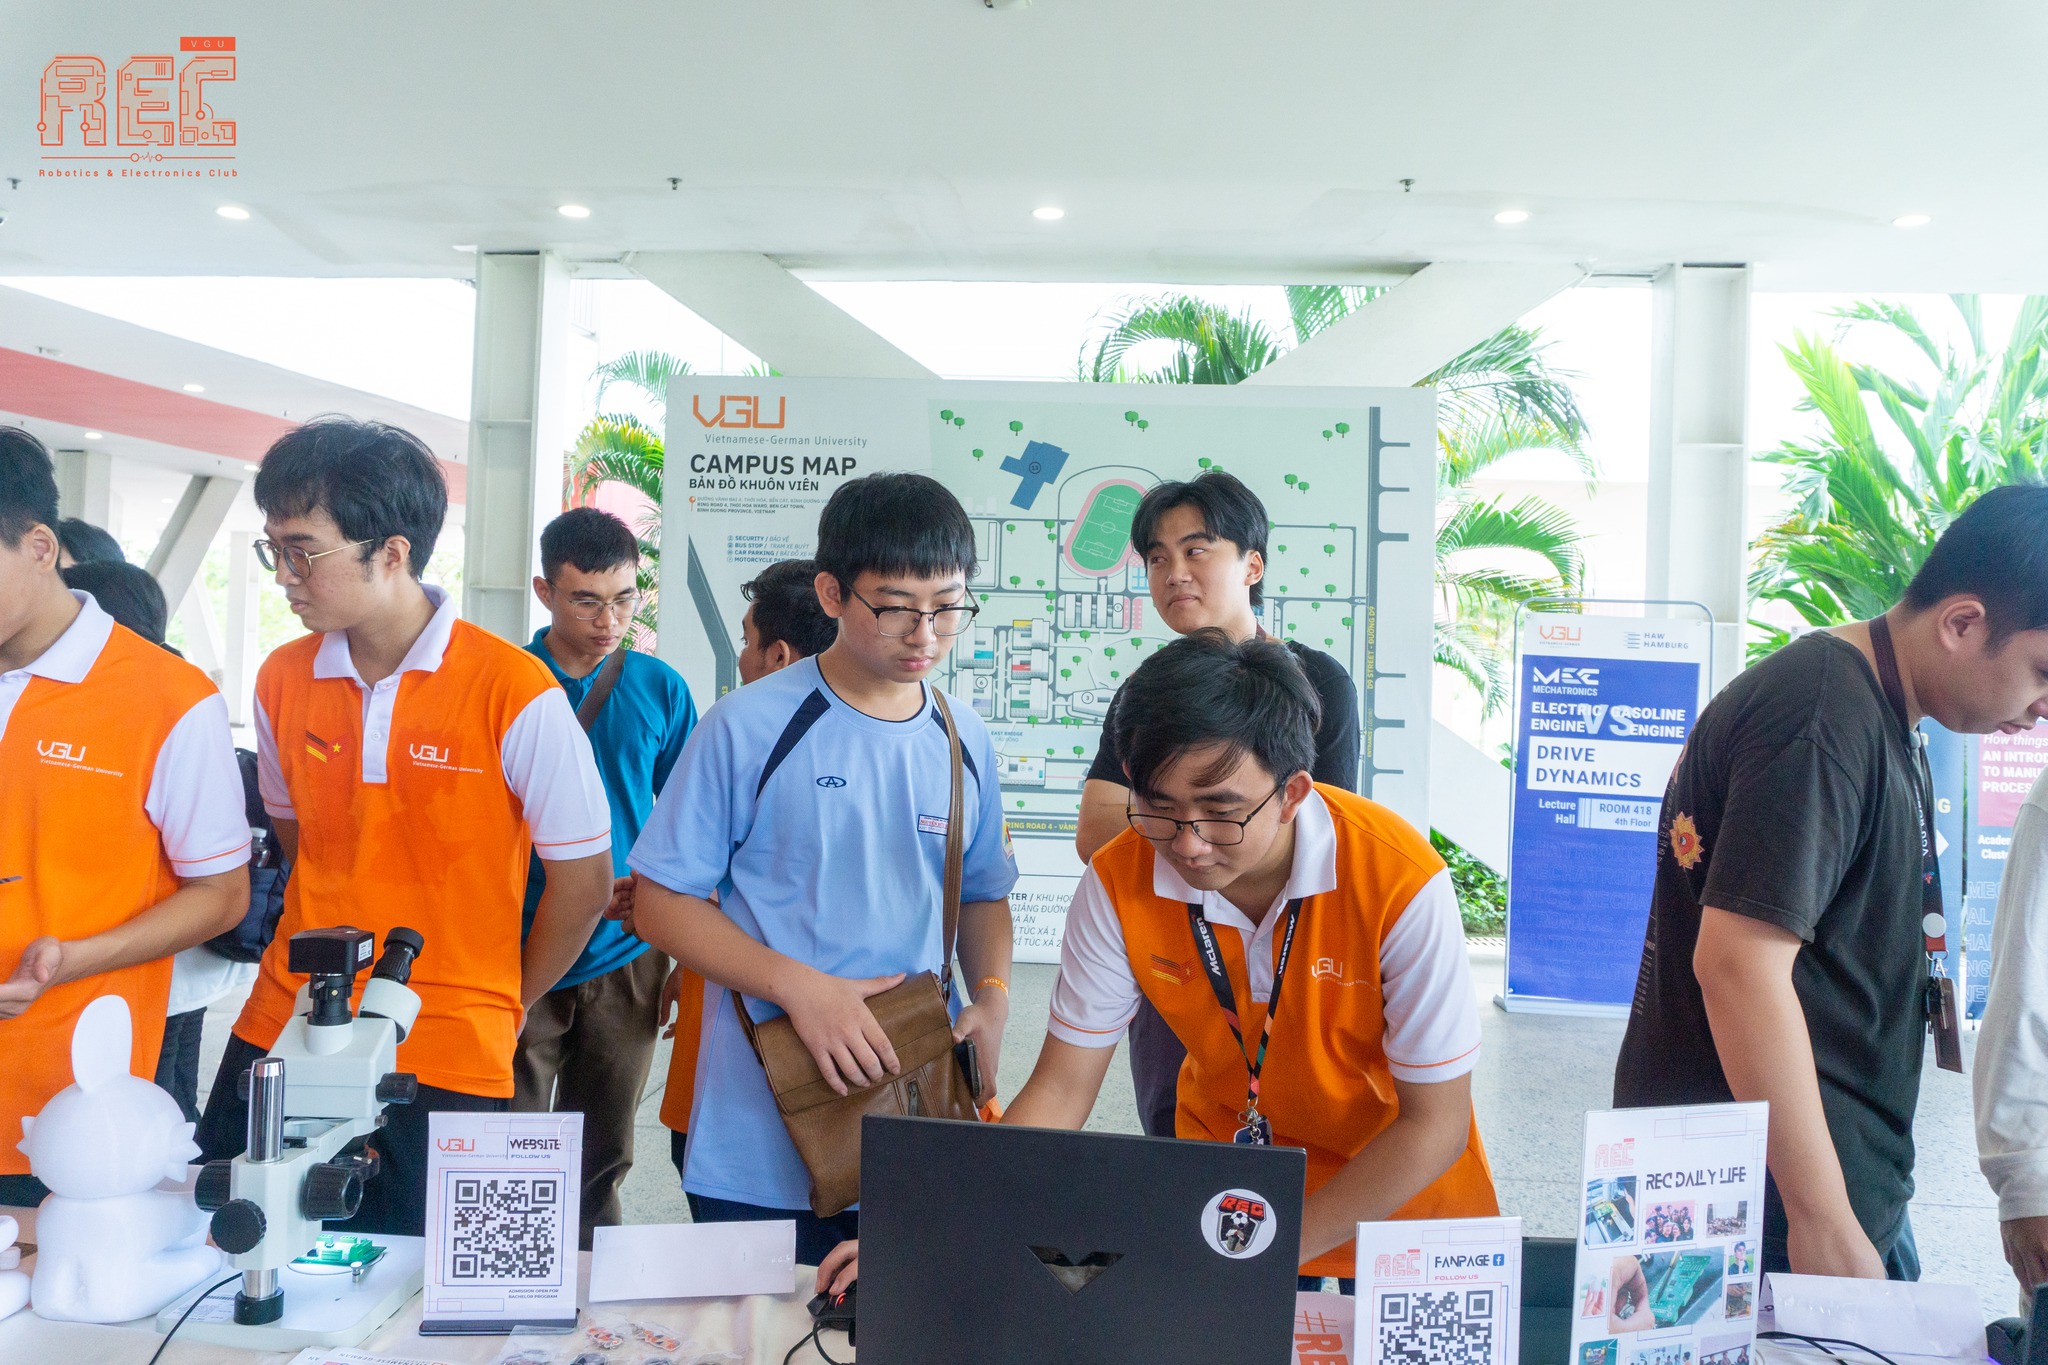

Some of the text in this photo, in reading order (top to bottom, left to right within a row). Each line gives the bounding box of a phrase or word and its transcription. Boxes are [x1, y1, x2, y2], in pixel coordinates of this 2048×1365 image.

[693, 395, 786, 429] VGU
[705, 433, 868, 449] Vietnamese-German University
[690, 454, 857, 476] CAMPUS MAP
[689, 475, 819, 491] BẢN ĐỒ KHUÔN VIÊN
[1368, 606, 1375, 616] D9
[1539, 625, 1582, 641] VGU
[1644, 632, 1665, 640] HAW
[1644, 641, 1689, 650] HAMBURG
[1367, 679, 1374, 689] D9
[1532, 685, 1598, 697] MECHATRONICS
[1531, 702, 1602, 718] ELECTRIC
[1610, 705, 1686, 722] GASOLINE
[1530, 718, 1685, 738] ENGINE ENGINE
[1984, 734, 2010, 745] How
[37, 740, 86, 762] VGU
[409, 743, 449, 763] VGU
[1537, 745, 1596, 762] DRIVE
[1983, 750, 2001, 762] AN
[40, 758, 124, 778] Vietnamese-German University
[413, 760, 484, 774] Vietnamese-German University
[1982, 765, 2000, 777] TO
[1536, 768, 1641, 788] DYNAMICS
[1539, 798, 1576, 811] Lecture
[1600, 803, 1652, 816] ROOM 418
[1555, 814, 1575, 824] Hall
[1614, 818, 1651, 828] 4th Floor
[1007, 893, 1027, 901] TER
[1019, 925, 1036, 935] TÚC
[1051, 928, 1057, 936] 1
[1025, 936, 1041, 946] TÚC
[1056, 939, 1062, 947] 2
[1196, 917, 1222, 977] McLaren
[1278, 914, 1295, 975] McLaren
[437, 1138, 475, 1152] VGU
[509, 1138, 561, 1150] WEBSITE
[1646, 1172, 1673, 1190] REC
[1719, 1166, 1747, 1184] LIFE
[1219, 1195, 1265, 1217] REC
[1434, 1255, 1490, 1268] FANPAGE
